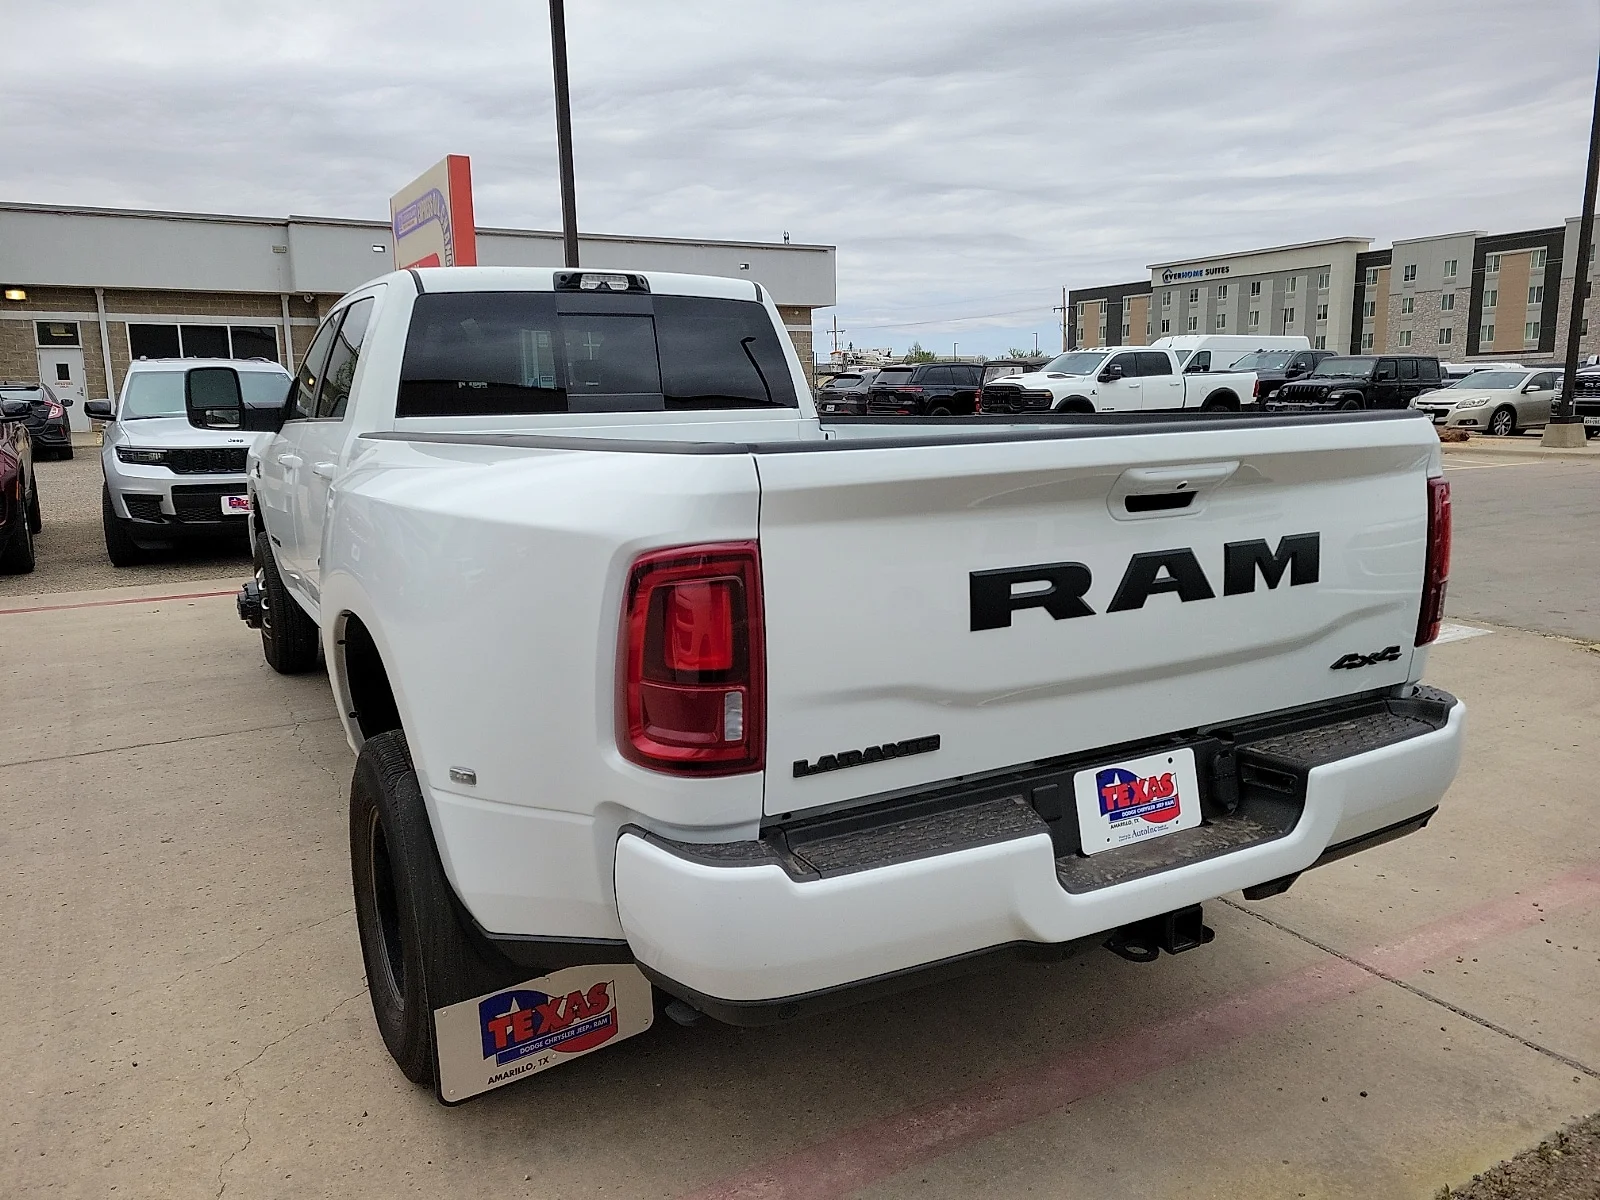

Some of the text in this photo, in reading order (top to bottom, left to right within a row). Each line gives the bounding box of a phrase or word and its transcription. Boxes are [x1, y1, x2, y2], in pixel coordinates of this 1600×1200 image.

[1165, 266, 1229, 281] EVERHOME SUITES
[969, 532, 1320, 632] RAM
[793, 734, 940, 777] LARAMIE
[1102, 773, 1174, 810] TEXAS
[1137, 804, 1155, 813] CHRYSLER
[488, 982, 610, 1049] TEXAS
[520, 1042, 543, 1054] DODGE
[544, 1031, 575, 1046] CHRYSLER
[593, 1018, 608, 1027] RAM
[487, 1056, 549, 1084] AMARILLO, TX
